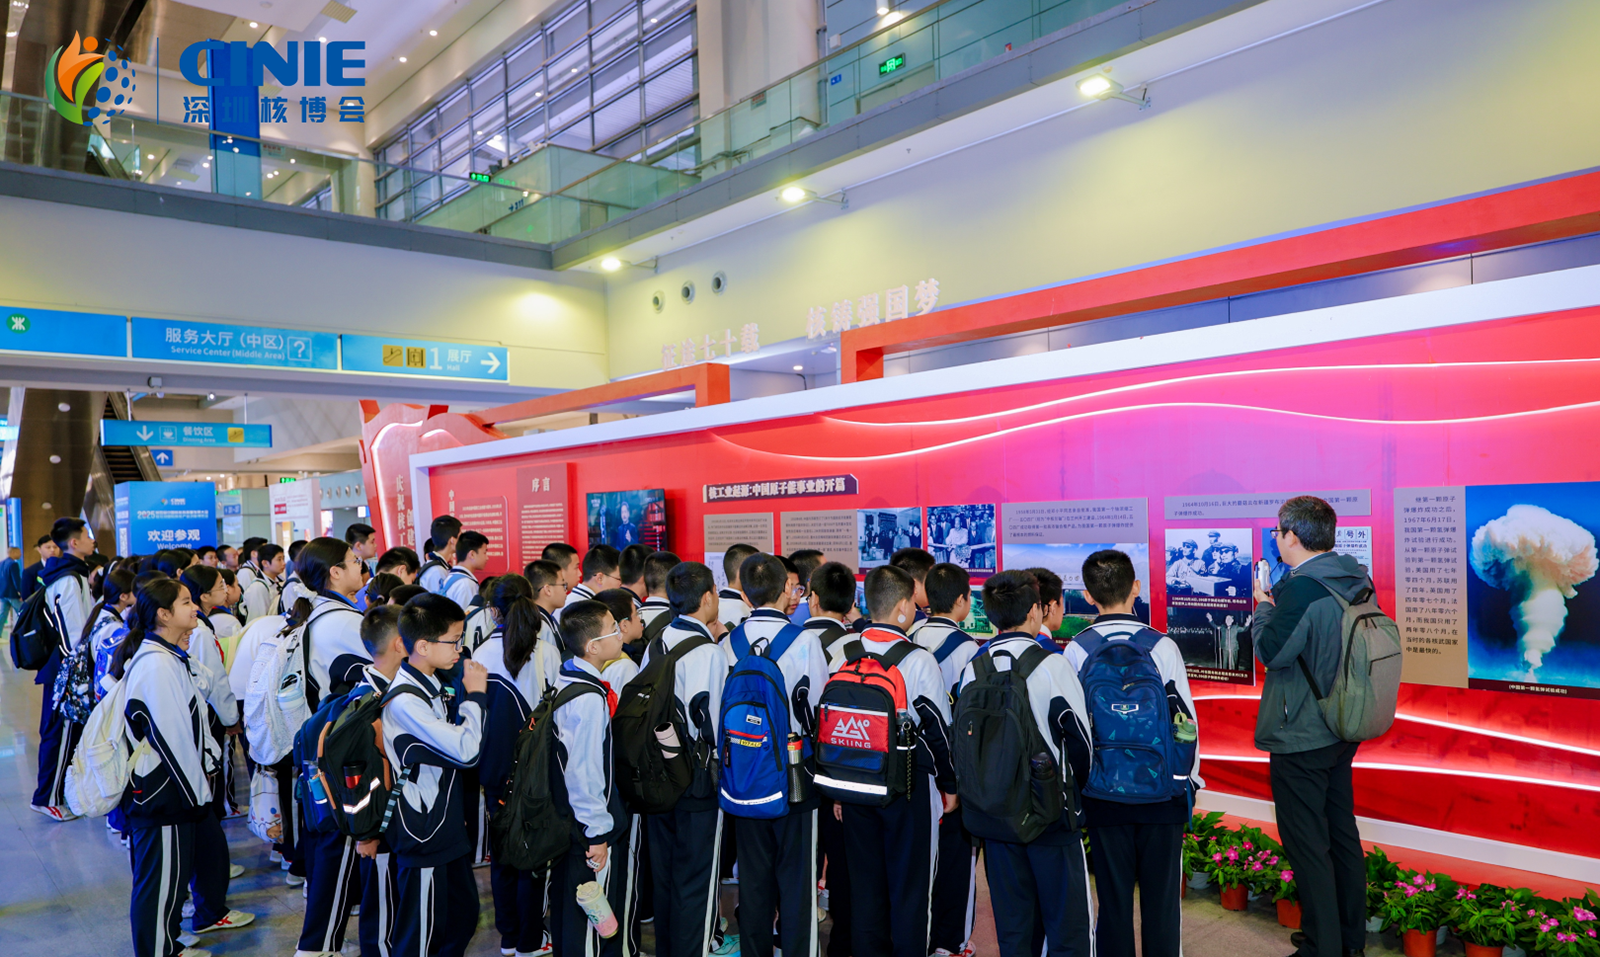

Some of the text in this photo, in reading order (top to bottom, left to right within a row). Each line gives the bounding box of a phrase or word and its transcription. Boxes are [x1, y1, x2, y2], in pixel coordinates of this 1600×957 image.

[806, 278, 940, 339] 核铸强国梦
[171, 345, 285, 361] Service Center (Middle Area)
[429, 347, 472, 370] 1 展厅
[183, 426, 214, 437] 餐饮区
[531, 477, 551, 493] 序言
[396, 474, 407, 548] 庆祝核工
[147, 529, 201, 542] 欢迎参观
[157, 542, 192, 550] Welcome
[830, 737, 872, 749] SKIING
